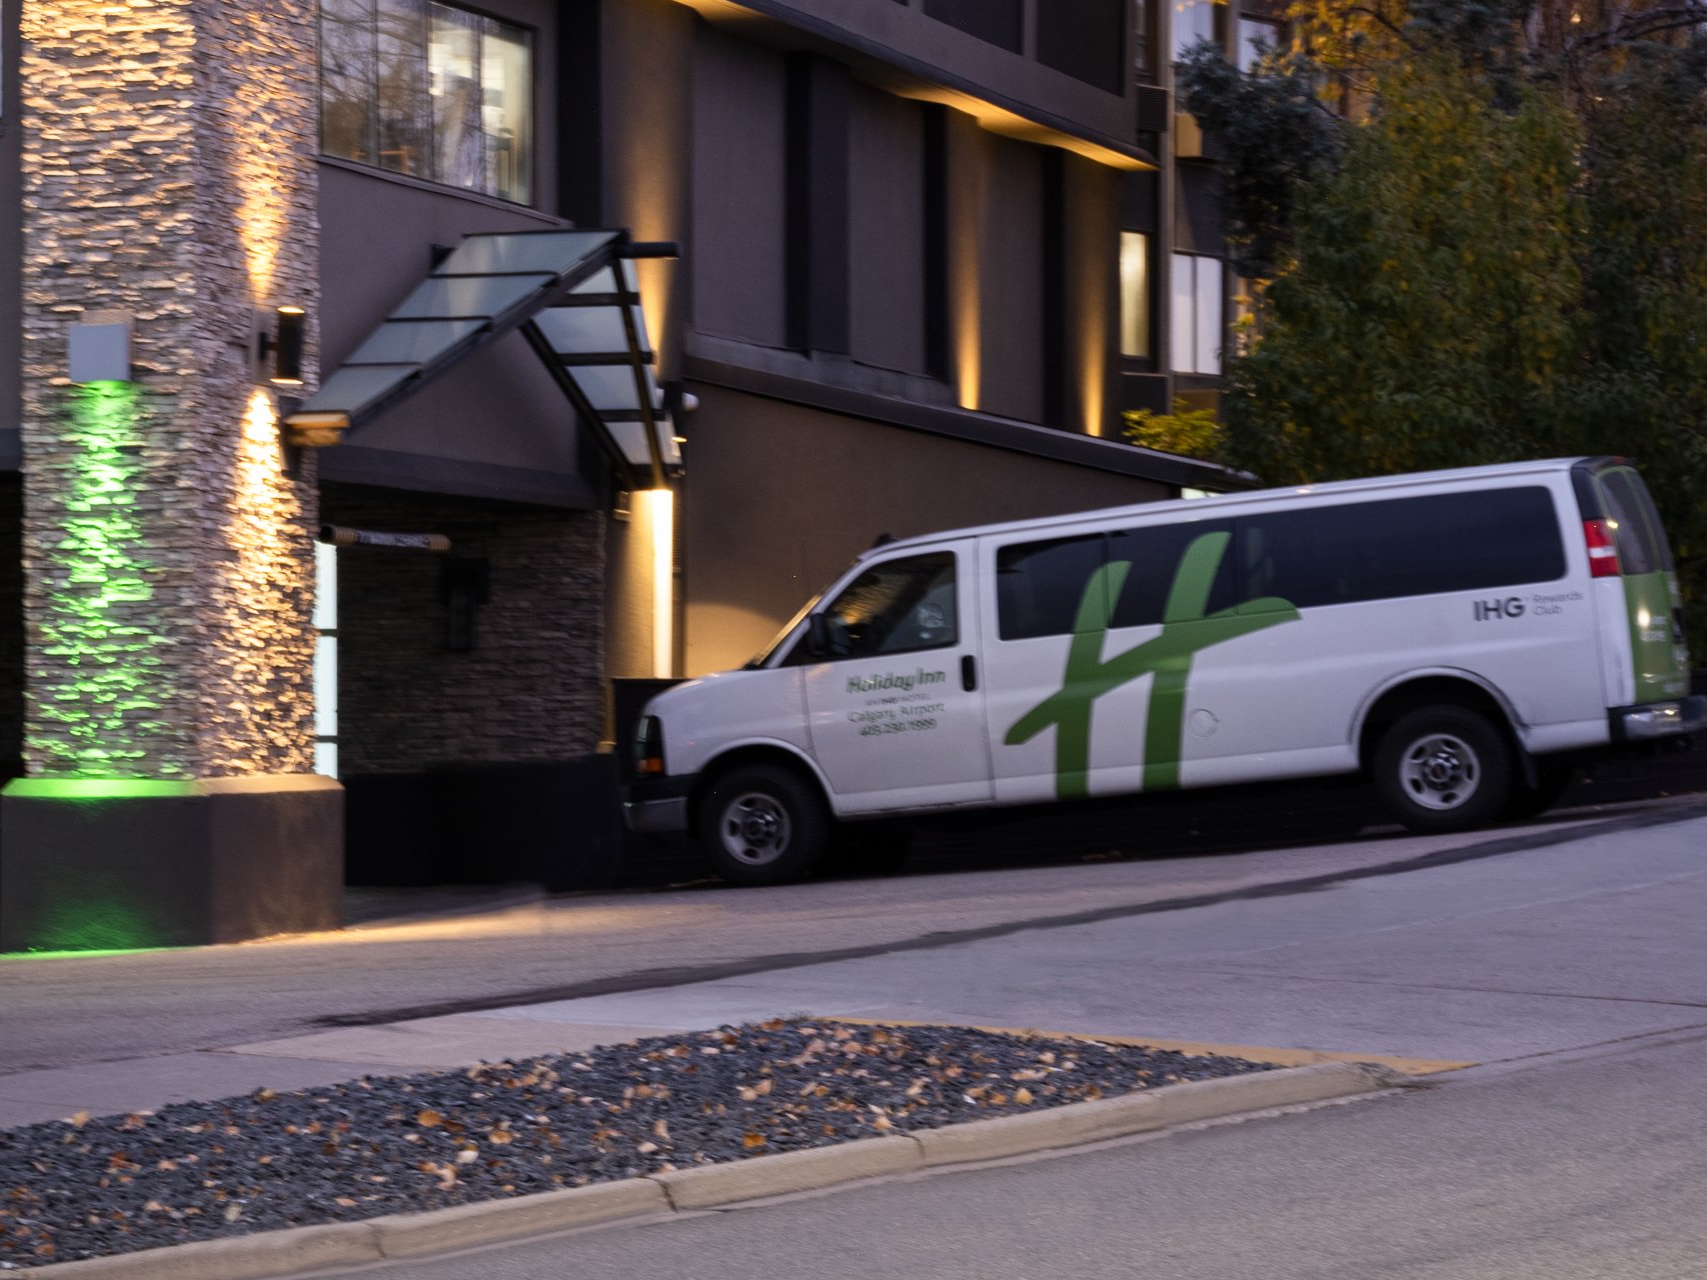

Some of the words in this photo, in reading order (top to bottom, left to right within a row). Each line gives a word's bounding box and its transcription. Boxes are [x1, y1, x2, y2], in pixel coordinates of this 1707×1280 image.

[1473, 597, 1525, 622] IHG
[846, 671, 915, 693] Holiday
[916, 667, 946, 686] Inn
[847, 709, 897, 723] Calgary
[900, 703, 946, 717] Airport
